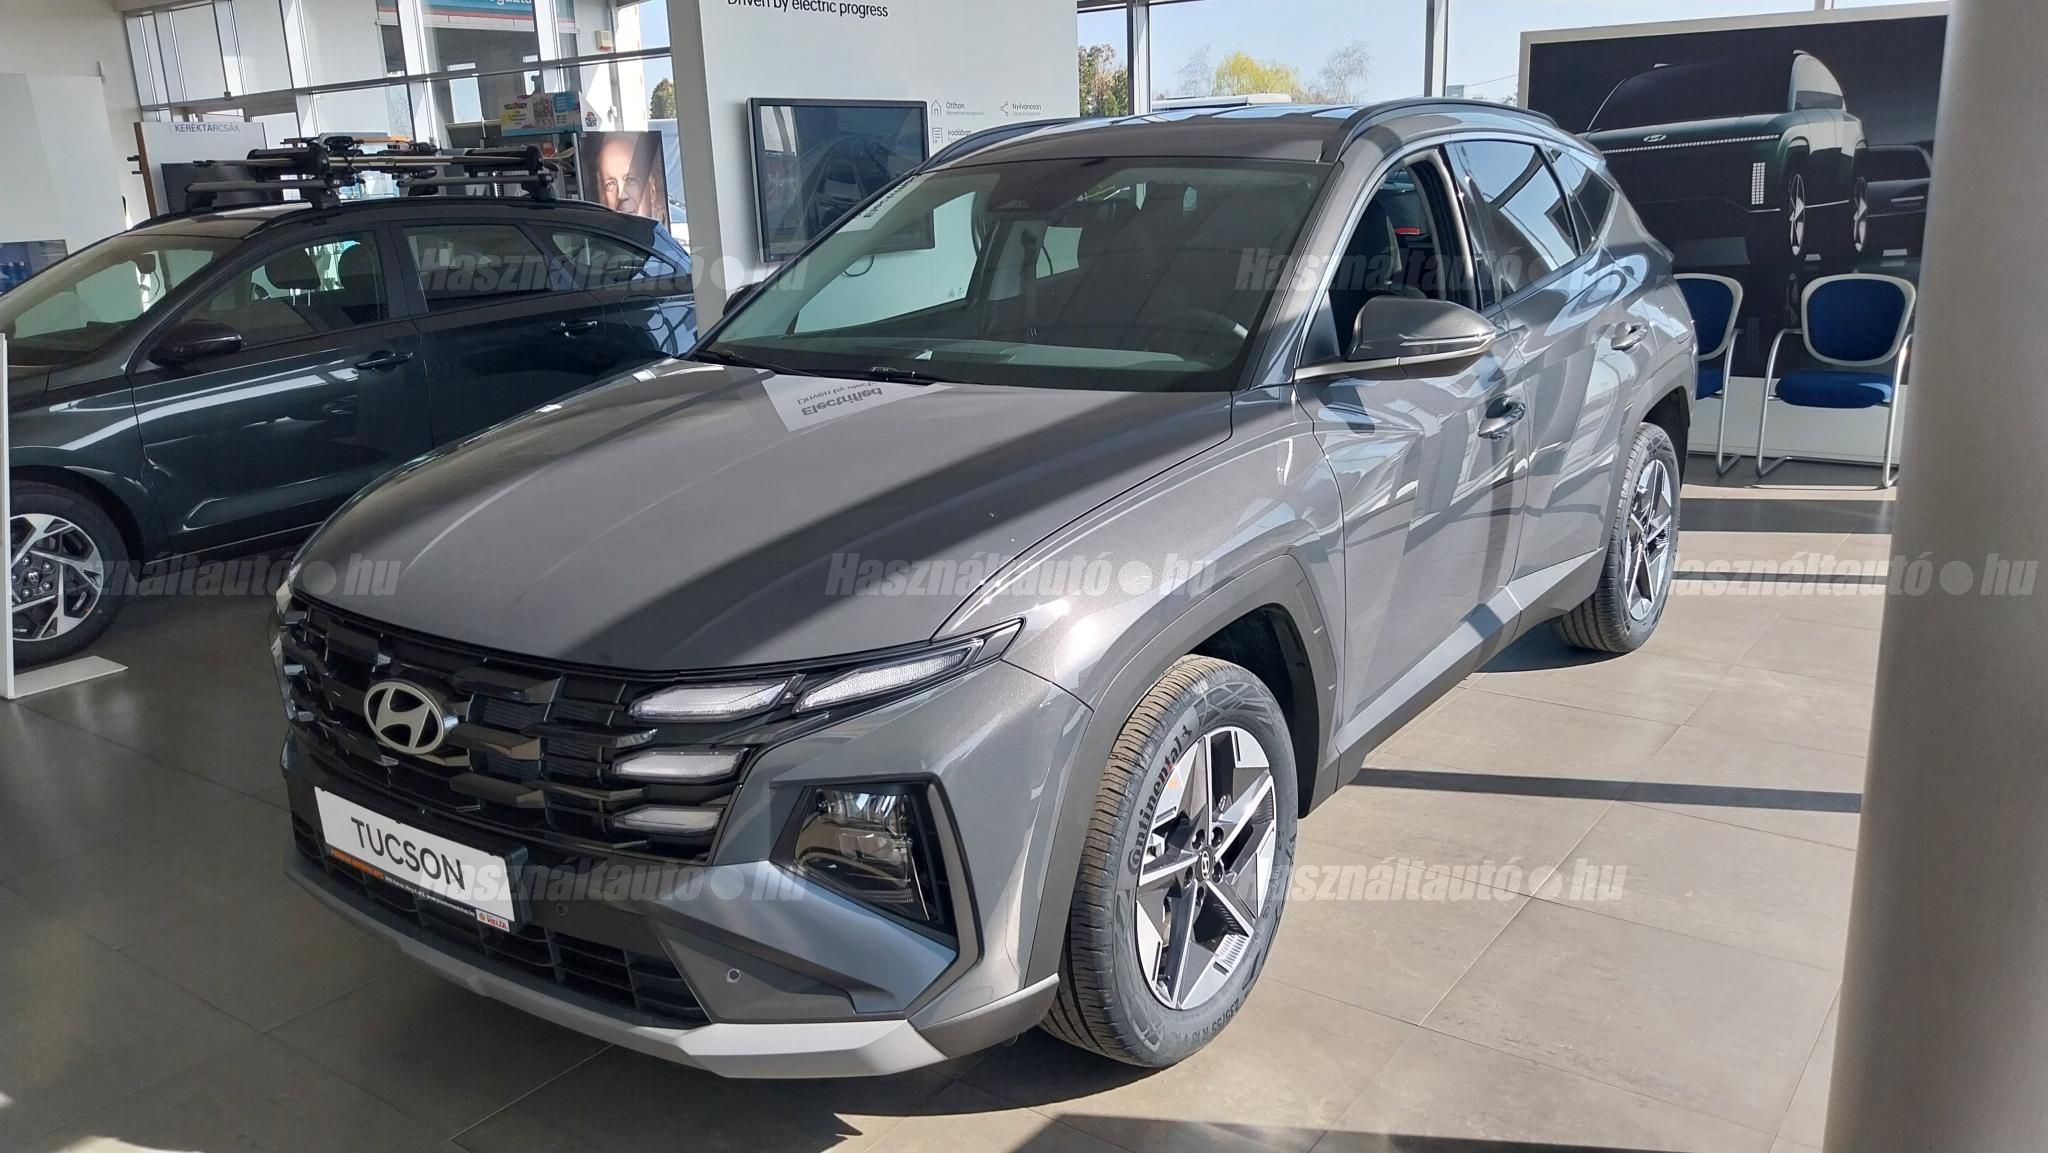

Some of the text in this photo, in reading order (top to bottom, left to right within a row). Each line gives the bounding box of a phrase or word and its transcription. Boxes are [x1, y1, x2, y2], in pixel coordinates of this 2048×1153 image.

[839, 2, 889, 18] progress
[945, 101, 965, 110] Otthon
[1127, 735, 1183, 875] Continental
[351, 816, 466, 890] TUCSON
